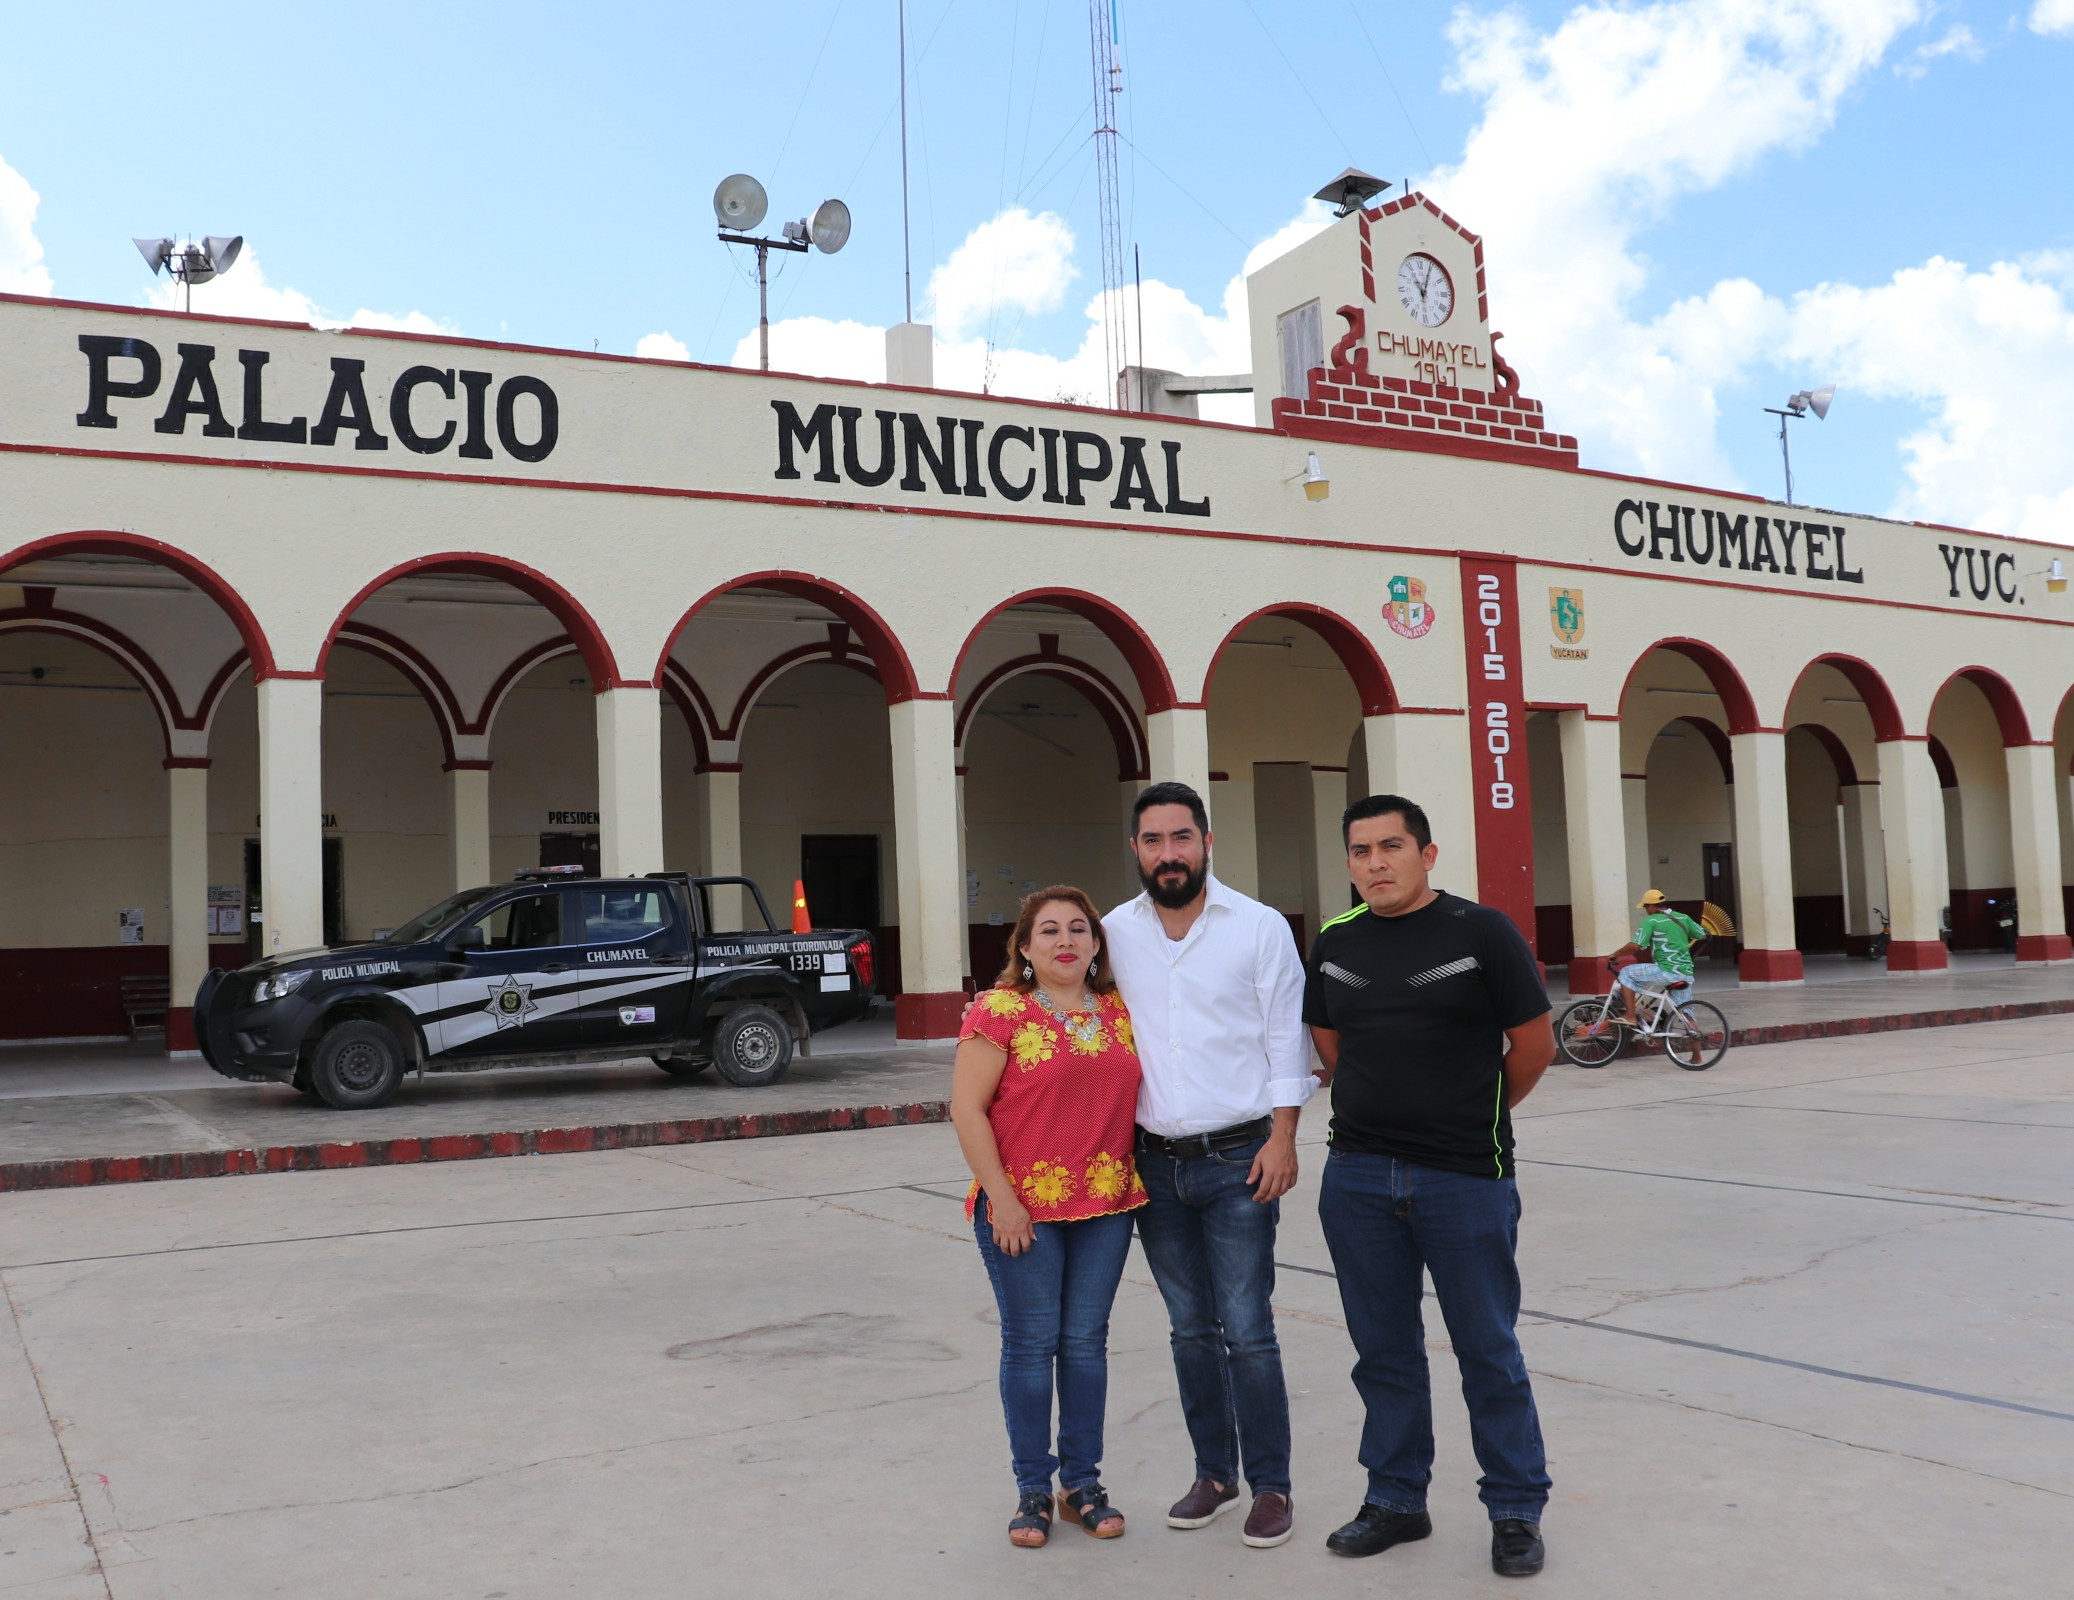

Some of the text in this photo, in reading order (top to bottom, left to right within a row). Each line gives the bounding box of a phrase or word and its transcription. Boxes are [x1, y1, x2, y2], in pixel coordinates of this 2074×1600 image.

[1377, 331, 1487, 368] CHUMAYEL
[1414, 360, 1457, 387] 1967
[76, 334, 1210, 517] PALACIO MUNICIPAL
[1614, 499, 2025, 606] CHUMAYEL YUC.
[1392, 620, 1430, 638] CHUMAYEL
[1477, 574, 1506, 681] 2015
[1553, 648, 1588, 659] YUCATAN
[1485, 702, 1515, 810] 2018
[587, 949, 650, 963] CHUMAYEL
[707, 940, 845, 957] POLICIA MUNICIPAL COORDINADA
[322, 960, 401, 981] POLICIA MUNICIPAL
[789, 954, 821, 971] 1339
